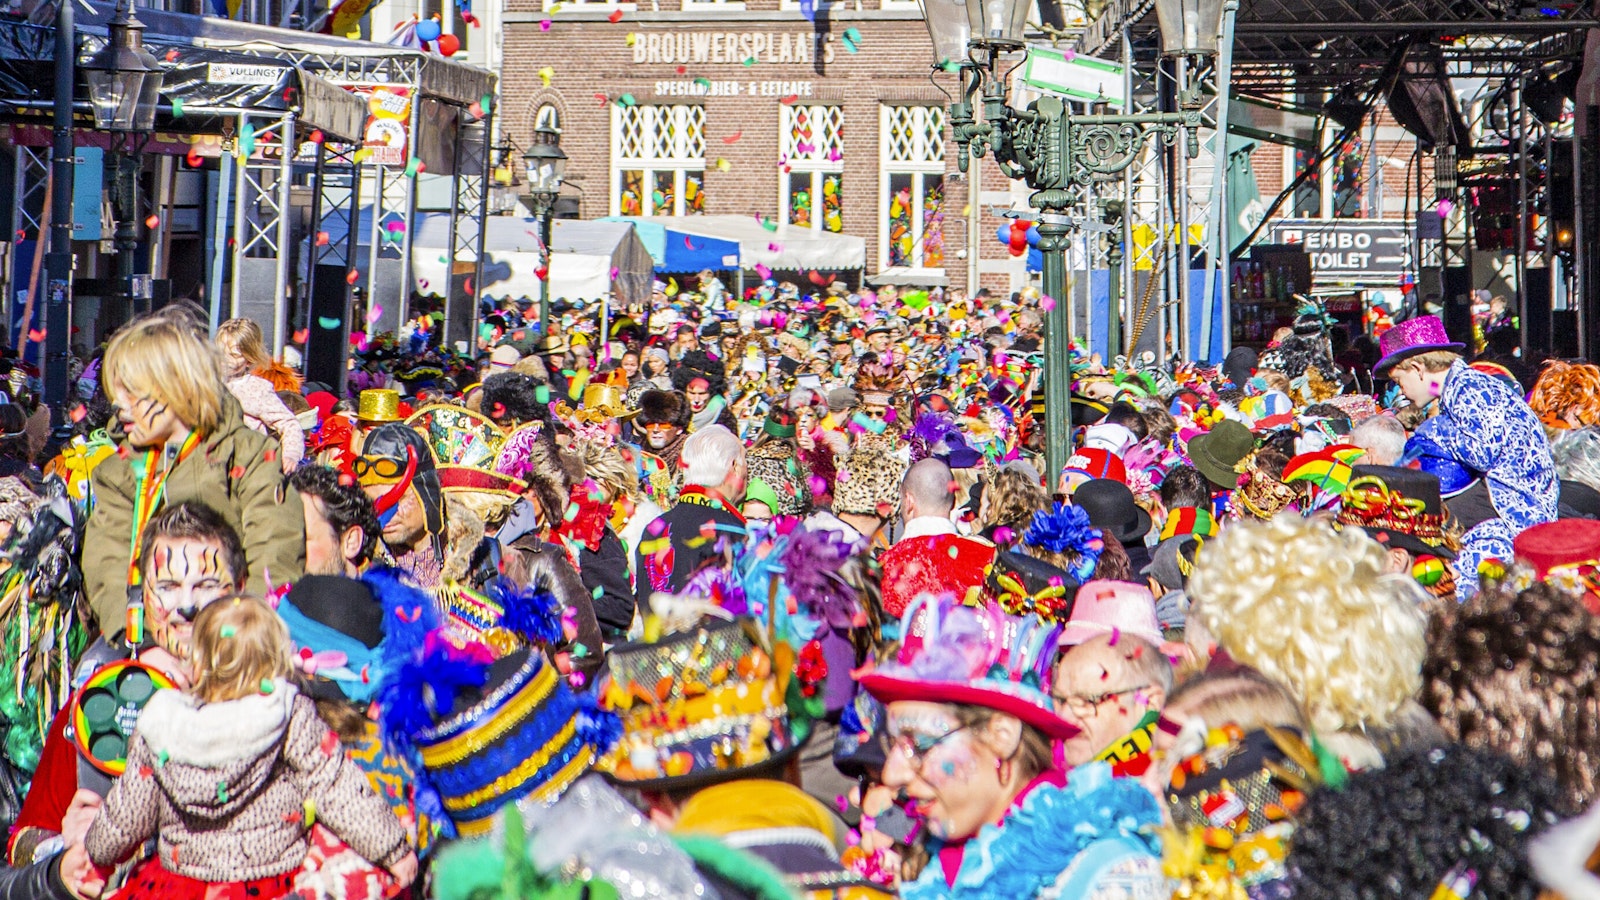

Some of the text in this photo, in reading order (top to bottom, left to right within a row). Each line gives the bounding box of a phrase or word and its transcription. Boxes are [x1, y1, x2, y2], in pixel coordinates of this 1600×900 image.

[633, 32, 835, 64] BROUWERSPLAATS
[229, 67, 276, 77] VULLINGS
[761, 81, 812, 96] EETCAFE
[1306, 232, 1372, 249] EHBO
[1311, 252, 1372, 269] TOILET
